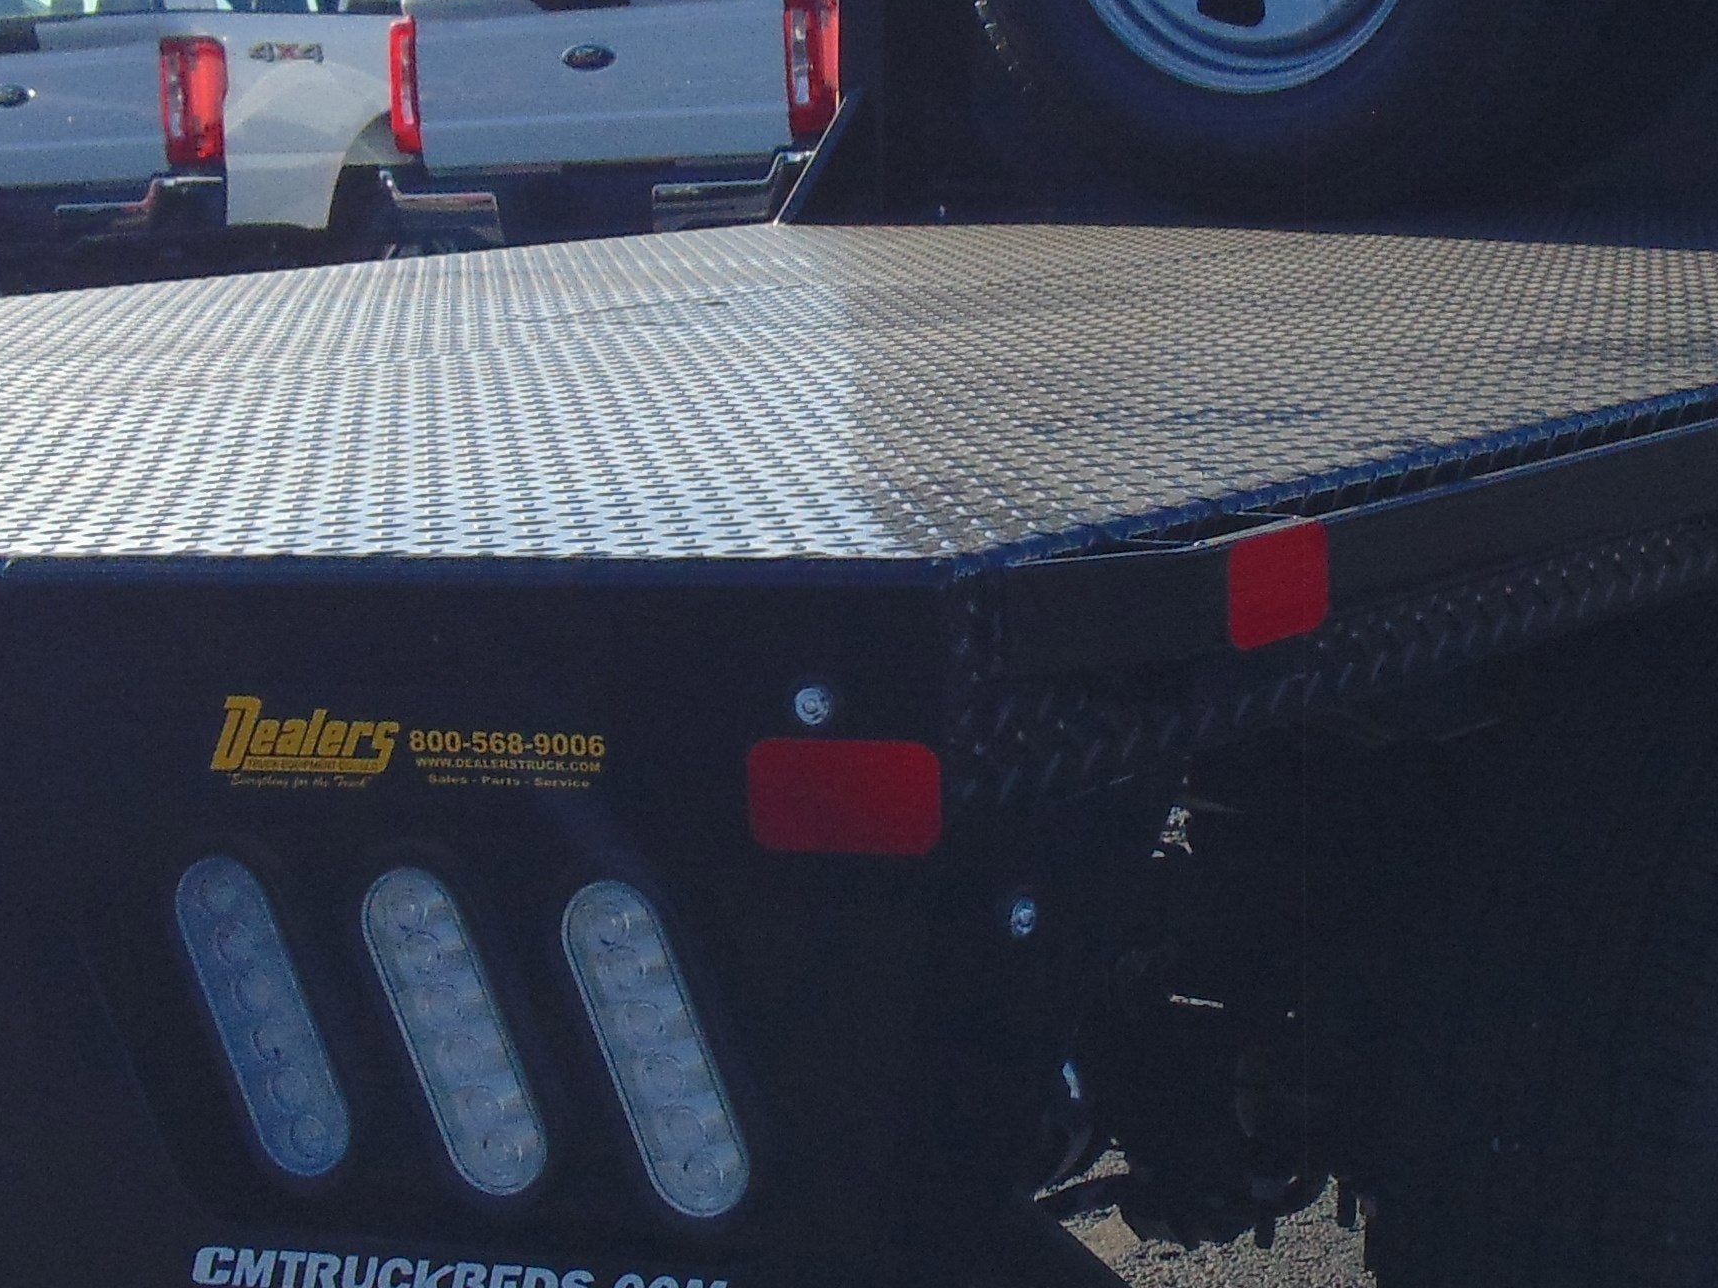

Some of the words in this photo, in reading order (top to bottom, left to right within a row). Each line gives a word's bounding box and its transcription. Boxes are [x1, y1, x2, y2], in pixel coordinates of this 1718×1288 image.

[211, 695, 400, 772] Dealers
[409, 729, 606, 758] 800-568-9006
[415, 757, 601, 773] WWW.DEALERSTRUCK.COM
[428, 773, 468, 785] Sales
[481, 775, 521, 787] Parts
[534, 777, 591, 789] Service
